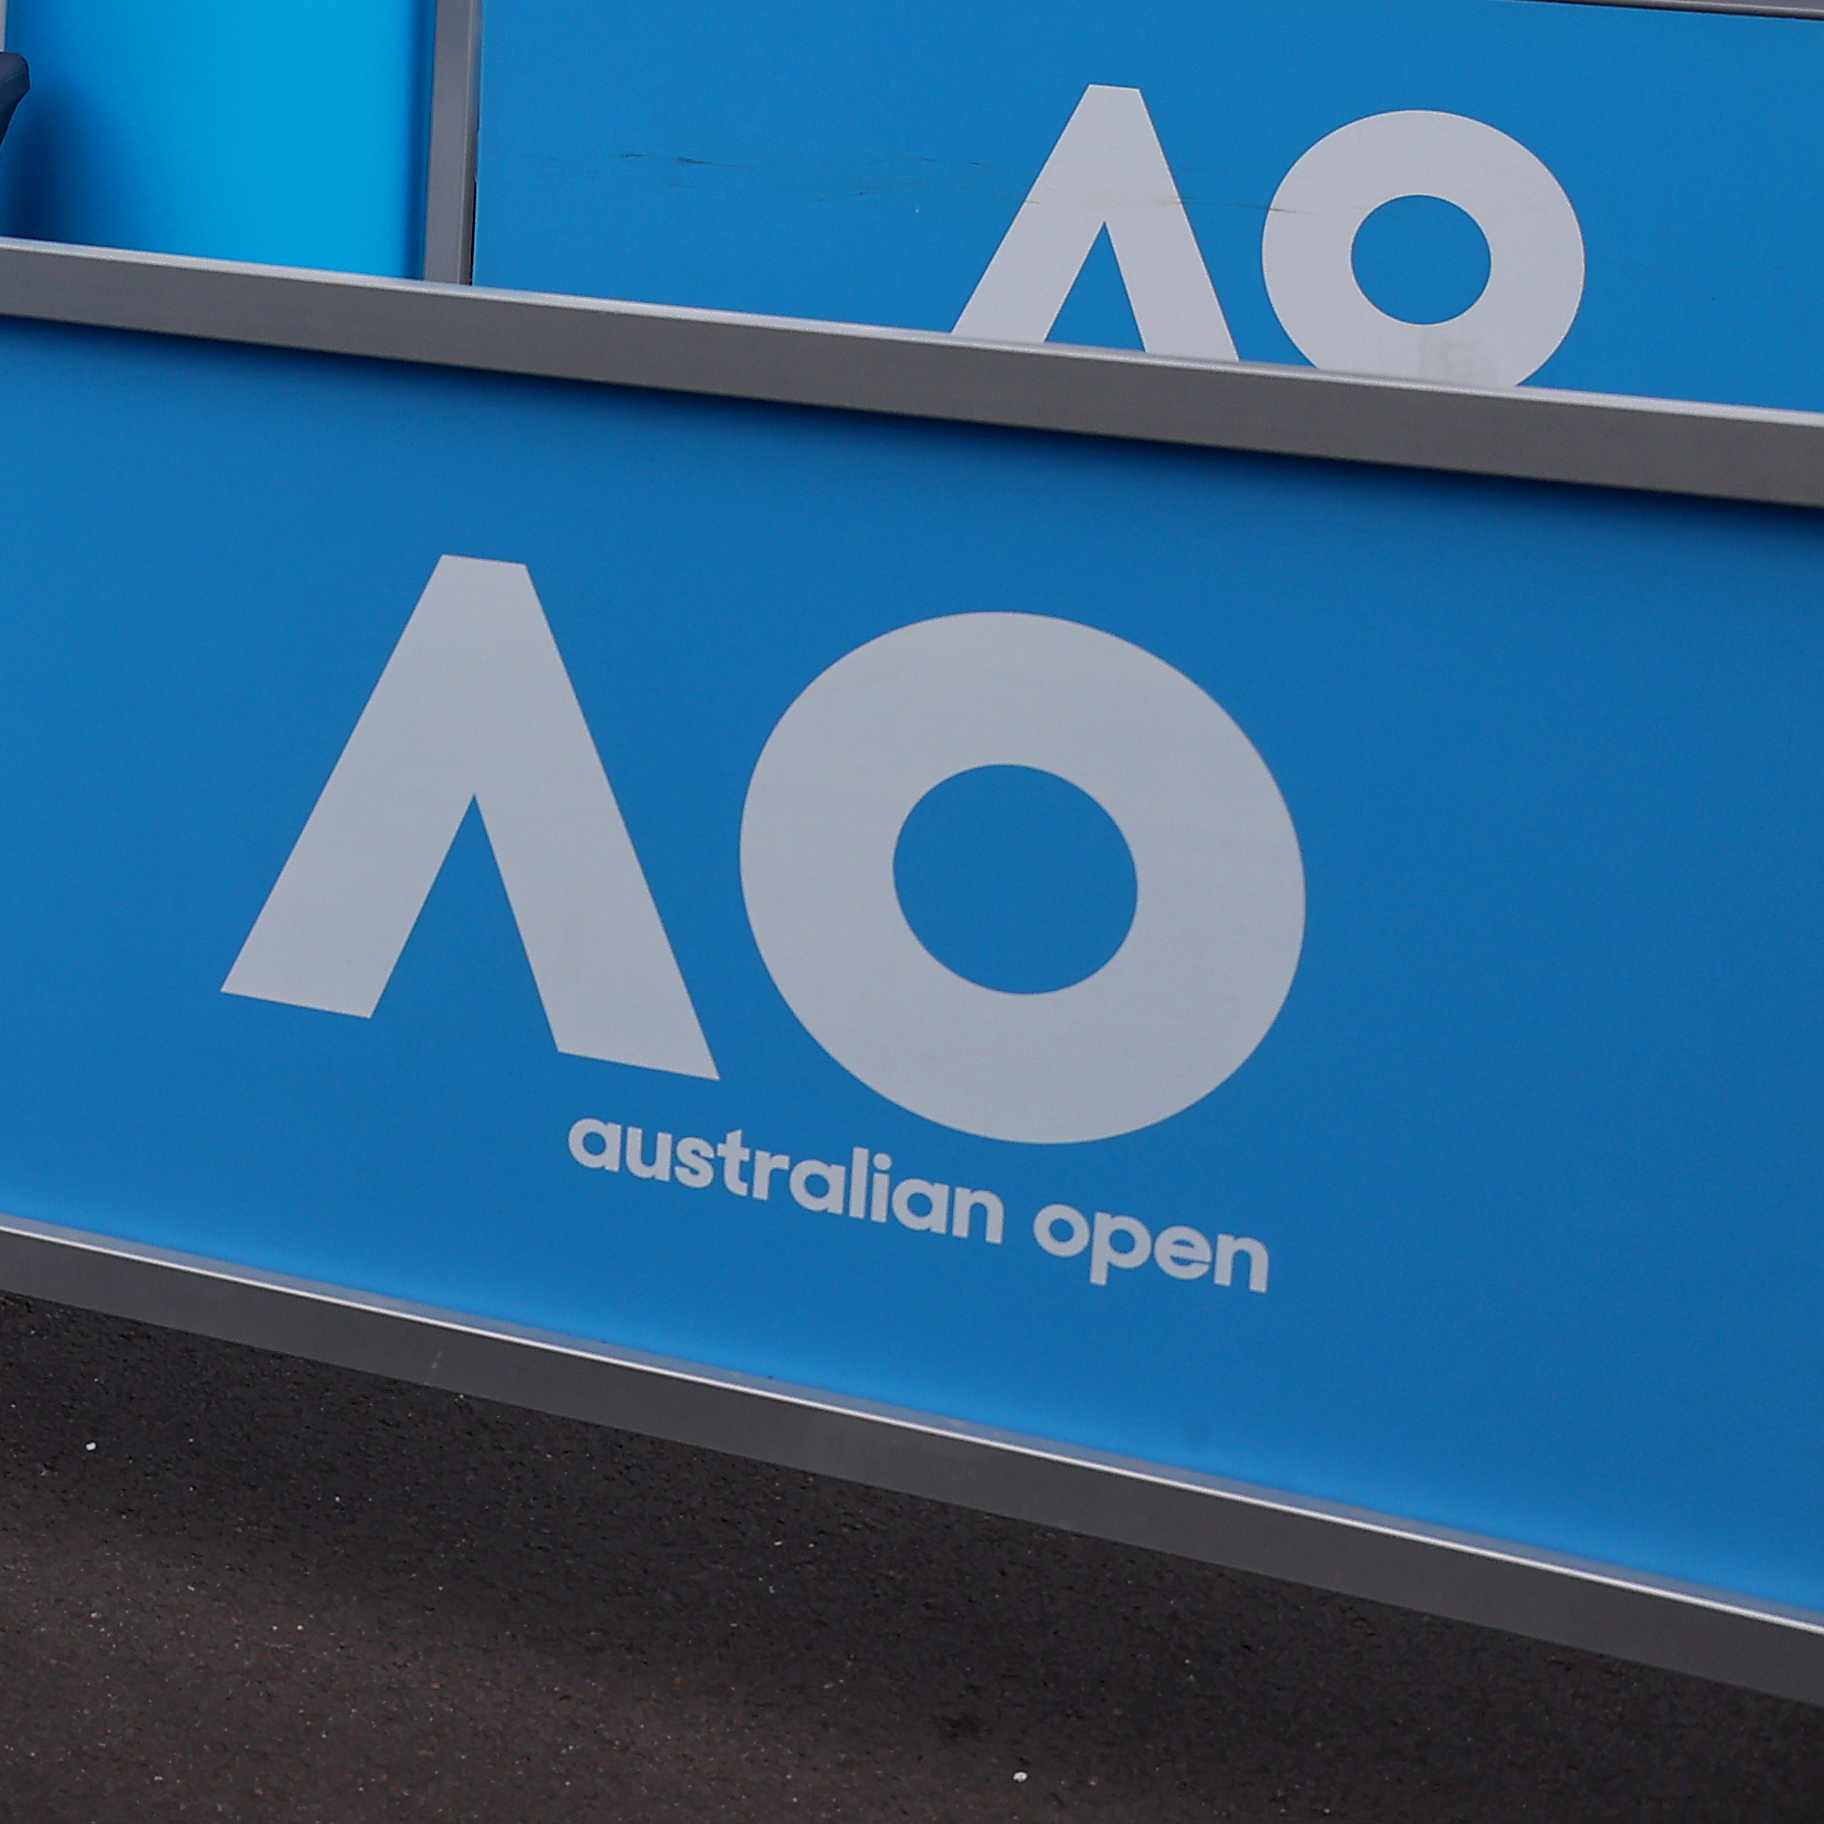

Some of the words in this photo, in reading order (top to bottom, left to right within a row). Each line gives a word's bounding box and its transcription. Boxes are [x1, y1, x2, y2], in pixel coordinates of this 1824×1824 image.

[951, 84, 1585, 388] AO
[219, 552, 1307, 1145] AO
[567, 1114, 1004, 1244] australian
[1032, 1199, 1271, 1294] open
